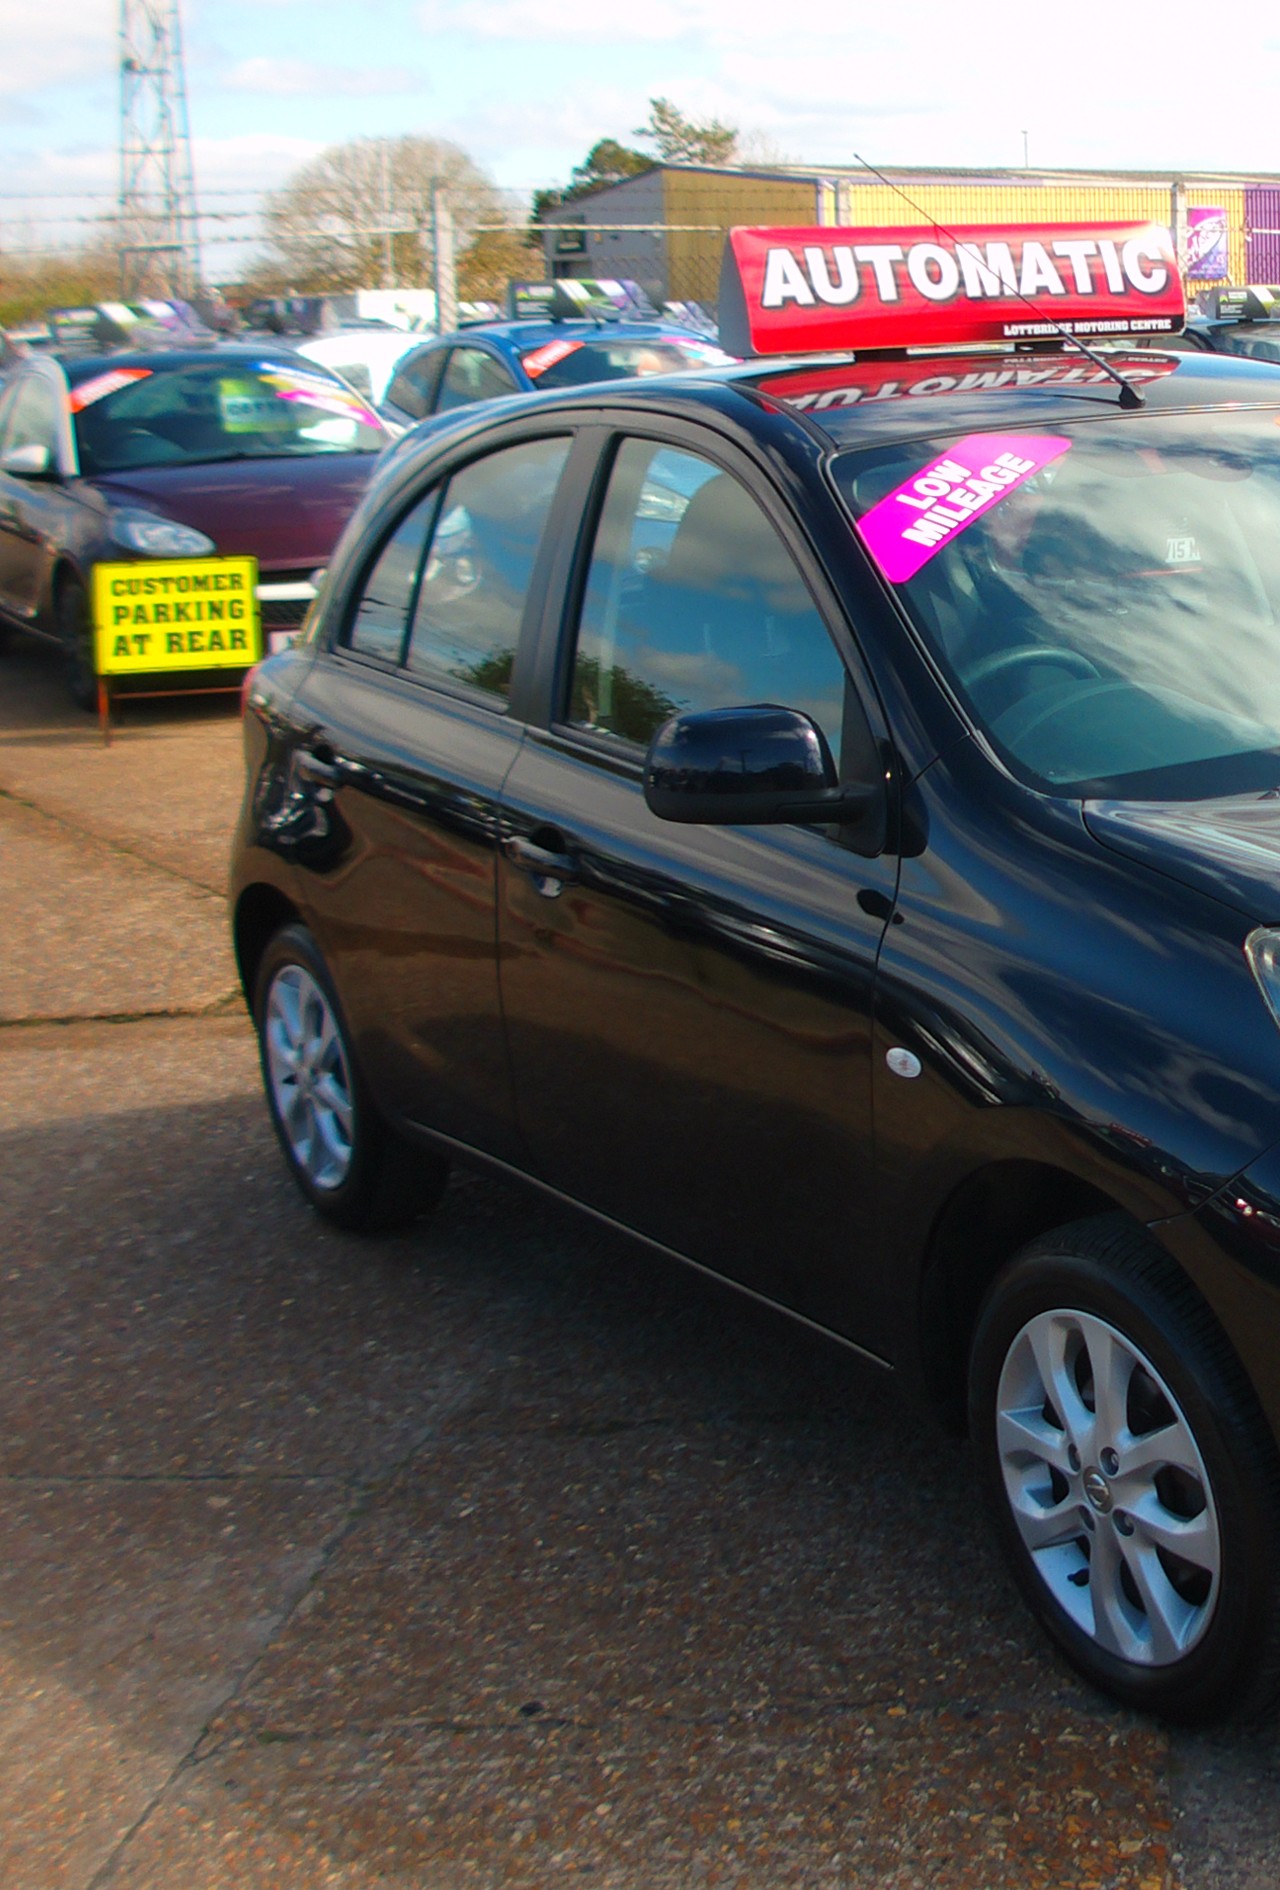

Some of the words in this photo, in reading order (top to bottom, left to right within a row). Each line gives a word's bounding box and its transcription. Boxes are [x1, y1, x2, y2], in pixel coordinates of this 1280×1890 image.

[761, 237, 1169, 308] AUTOMATIC
[1003, 322, 1073, 337] LOTTBRIDGE
[1074, 320, 1129, 333] MOTORING
[1130, 318, 1172, 331] CENTRE
[895, 458, 973, 511] LOW
[901, 451, 1036, 548] MILEAGE
[111, 573, 245, 597] CUSTOMER
[112, 599, 245, 626] PARKING
[113, 632, 152, 657] AT
[165, 628, 249, 654] REAR
